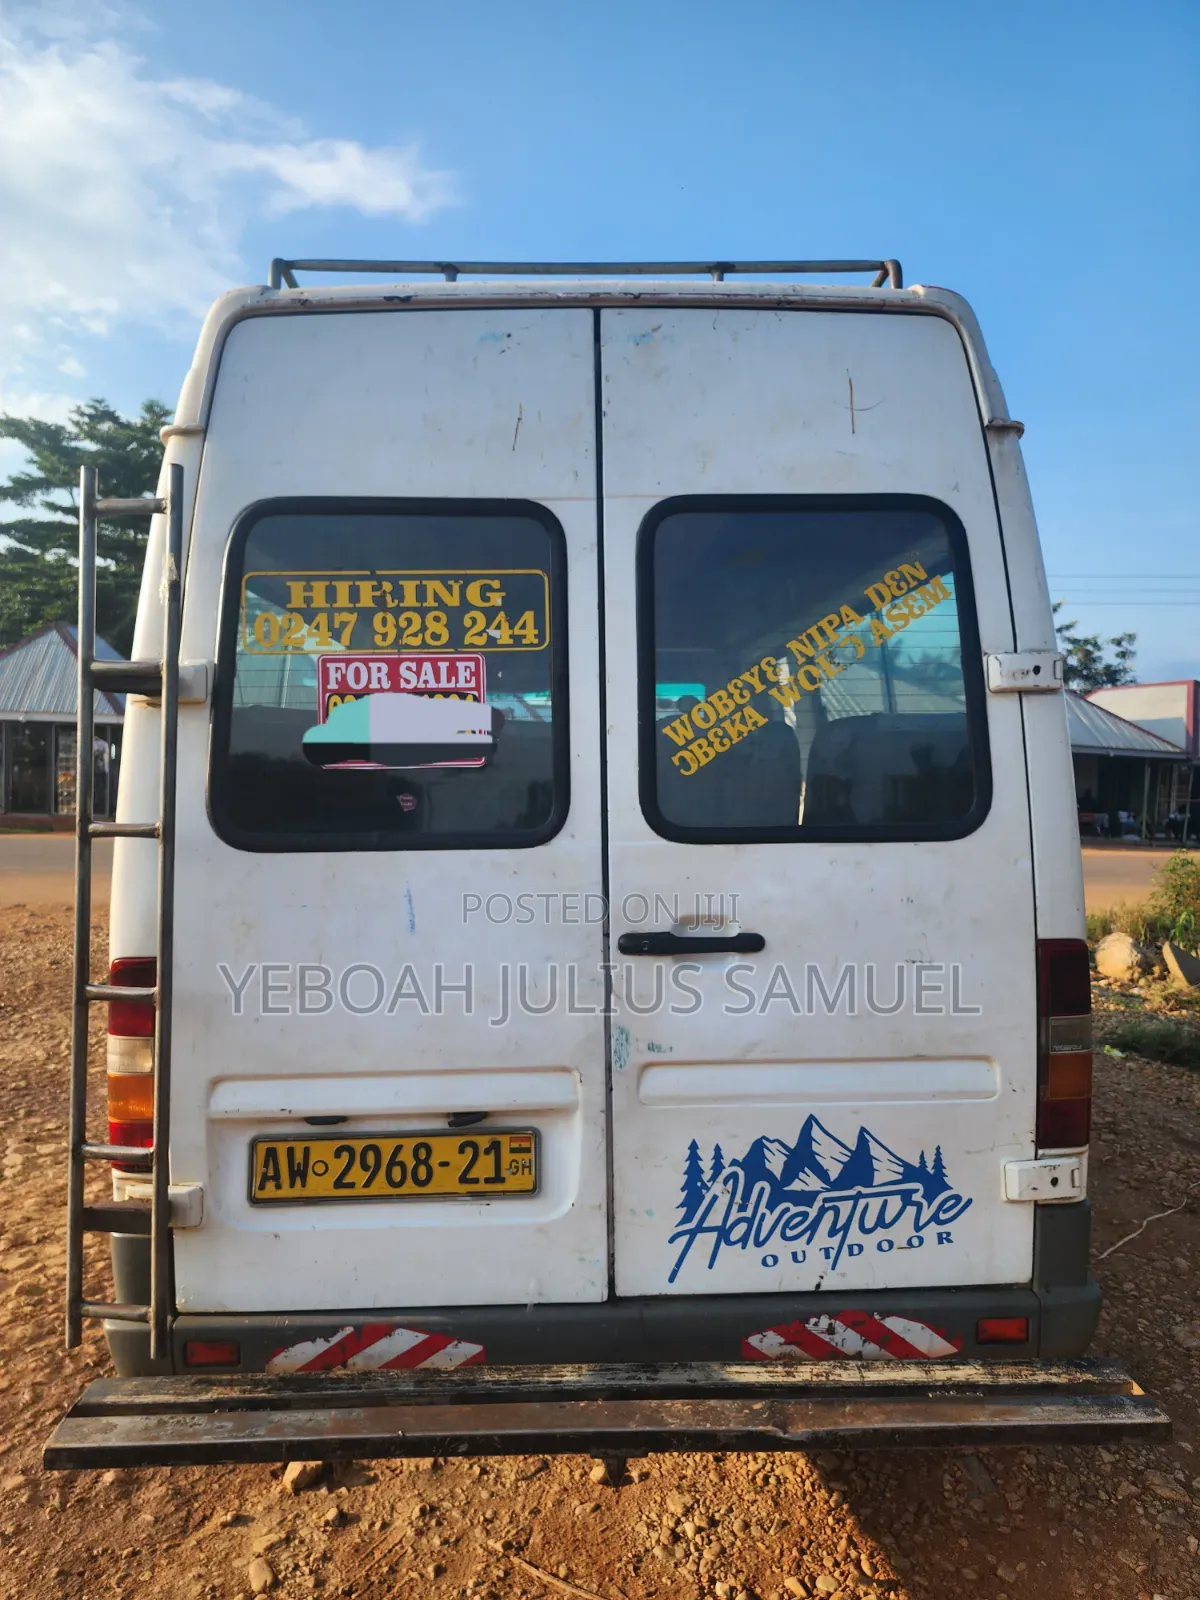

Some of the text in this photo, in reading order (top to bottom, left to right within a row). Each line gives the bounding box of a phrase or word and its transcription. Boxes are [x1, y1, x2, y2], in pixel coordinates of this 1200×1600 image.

[286, 579, 506, 609] HIRING
[254, 610, 539, 647] 0247 928 244
[785, 604, 865, 665] NIPA
[326, 661, 476, 690] FOR SALE
[509, 1158, 532, 1176] GH
[668, 1166, 973, 1284] Adventure
[761, 1231, 954, 1268] OUTDOOR
